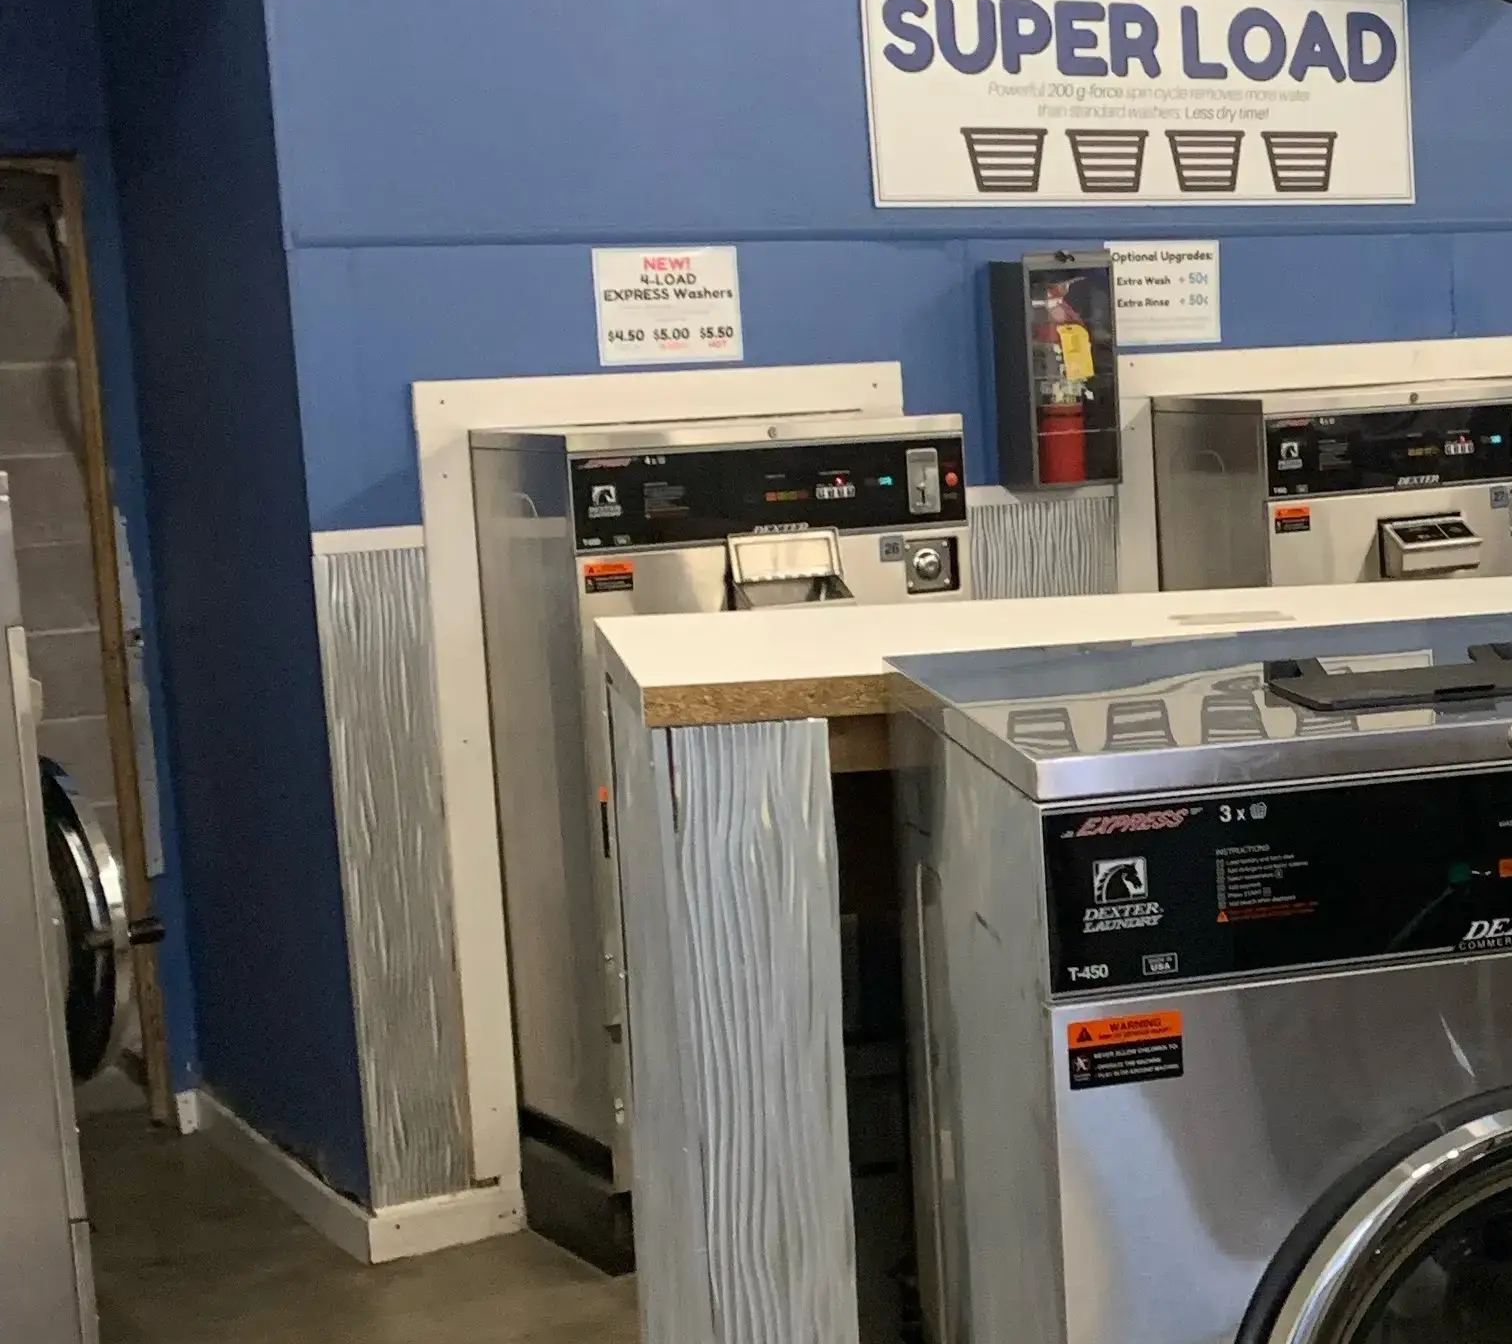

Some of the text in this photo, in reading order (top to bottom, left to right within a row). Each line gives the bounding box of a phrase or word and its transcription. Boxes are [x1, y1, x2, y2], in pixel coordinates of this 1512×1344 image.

[1180, 4, 1398, 84] LOAD
[988, 81, 1045, 98] Powerful
[1048, 83, 1074, 98] 200
[1125, 85, 1151, 102] spin
[1153, 86, 1189, 103] cycle
[1190, 89, 1244, 102] removes
[1245, 89, 1278, 102] more
[1278, 89, 1311, 103] water
[1037, 104, 1067, 118] than
[1069, 104, 1126, 119] standard
[1185, 105, 1215, 120] Less
[1216, 105, 1238, 123] dry
[1238, 106, 1270, 121] time!
[643, 256, 691, 271] NEW!
[1112, 251, 1158, 264] Optional
[640, 272, 697, 286] 4-LOAD
[1116, 276, 1143, 287] Extra
[1144, 275, 1171, 286] Wash
[603, 286, 733, 302] EXPRESS Washers
[1117, 298, 1143, 309] Extra
[1144, 297, 1170, 308] Rinse
[607, 325, 734, 343] $4.50 $5.00 $5.50
[1075, 807, 1189, 837] EXPRESS
[1219, 805, 1247, 822] 3 x
[1083, 901, 1160, 922] DEXTER
[1083, 914, 1164, 933] LAUNDRY
[1067, 963, 1109, 981] T-450
[1151, 962, 1171, 972] USA
[1109, 1017, 1162, 1033] WARNING
